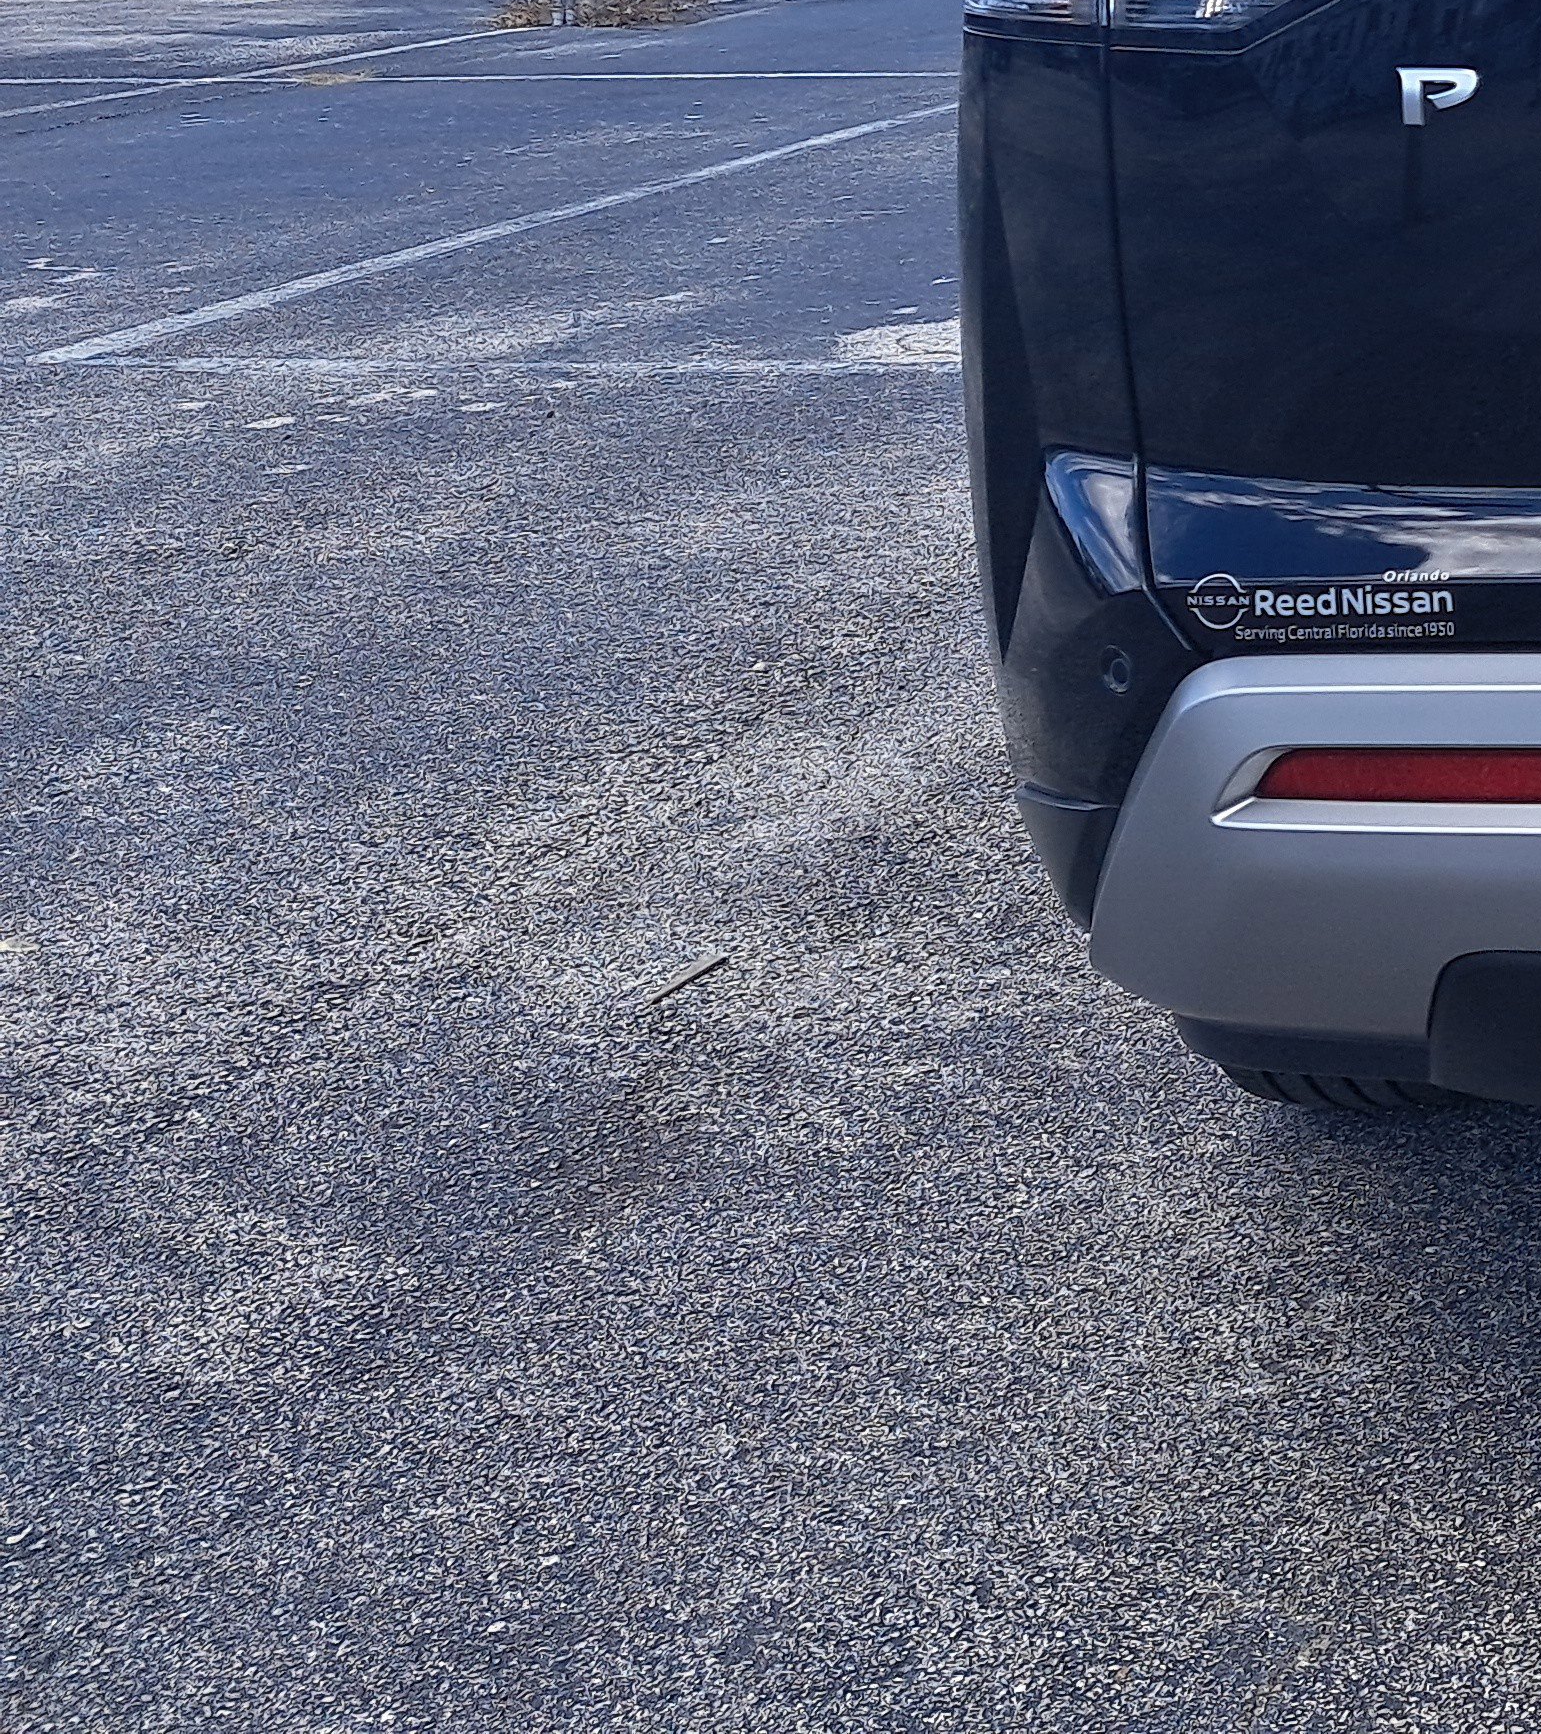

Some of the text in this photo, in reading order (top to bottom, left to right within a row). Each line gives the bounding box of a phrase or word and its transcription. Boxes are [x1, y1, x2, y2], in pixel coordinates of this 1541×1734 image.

[1382, 569, 1450, 583] Orlando
[1187, 595, 1250, 606] NISSAN
[1235, 625, 1286, 643] Serving
[1287, 625, 1336, 640] Central
[1337, 623, 1386, 639] Florida
